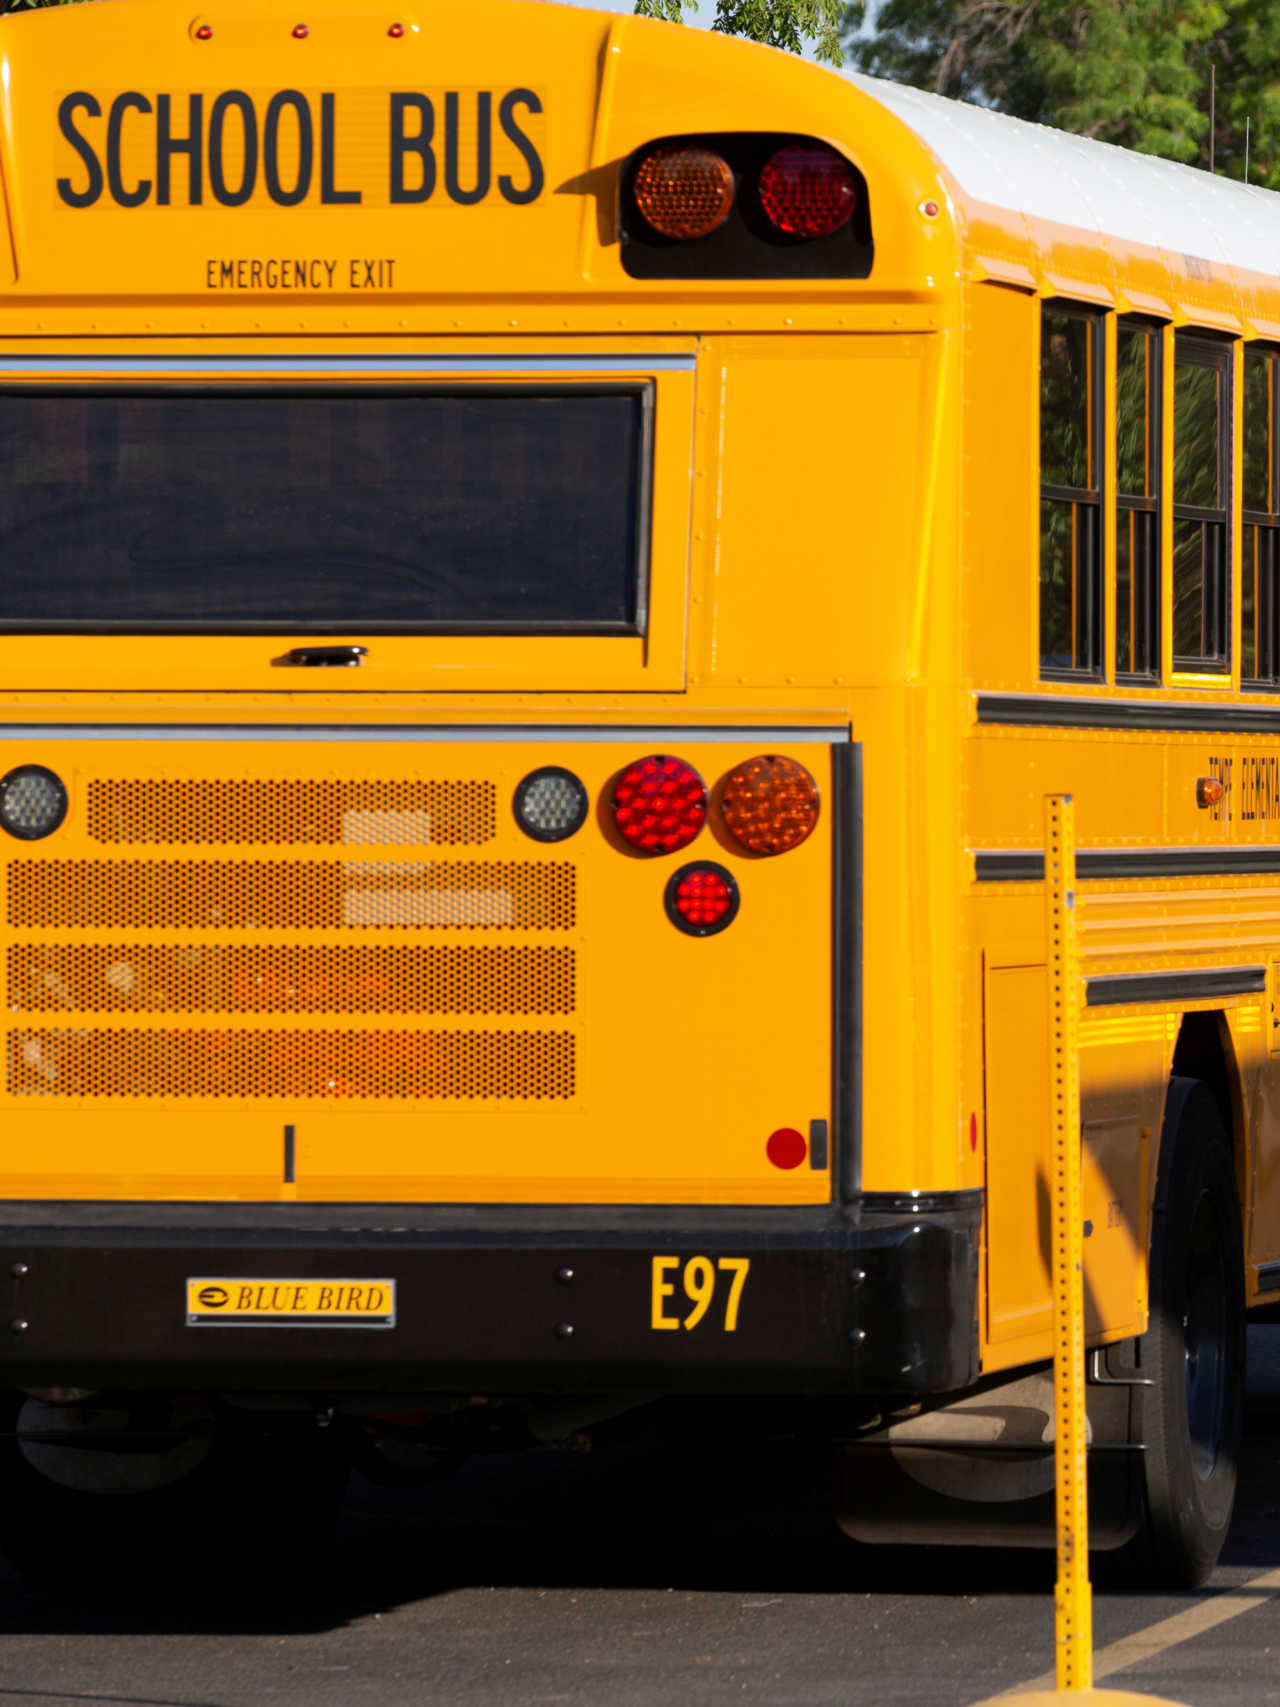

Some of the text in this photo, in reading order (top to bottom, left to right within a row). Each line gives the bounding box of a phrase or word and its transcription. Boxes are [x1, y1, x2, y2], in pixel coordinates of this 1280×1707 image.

[57, 87, 546, 209] SCHOOL BUS
[206, 259, 397, 290] EMERGENCY EXIT
[234, 1286, 386, 1312] BLUE BIRD
[650, 1254, 751, 1333] E97
